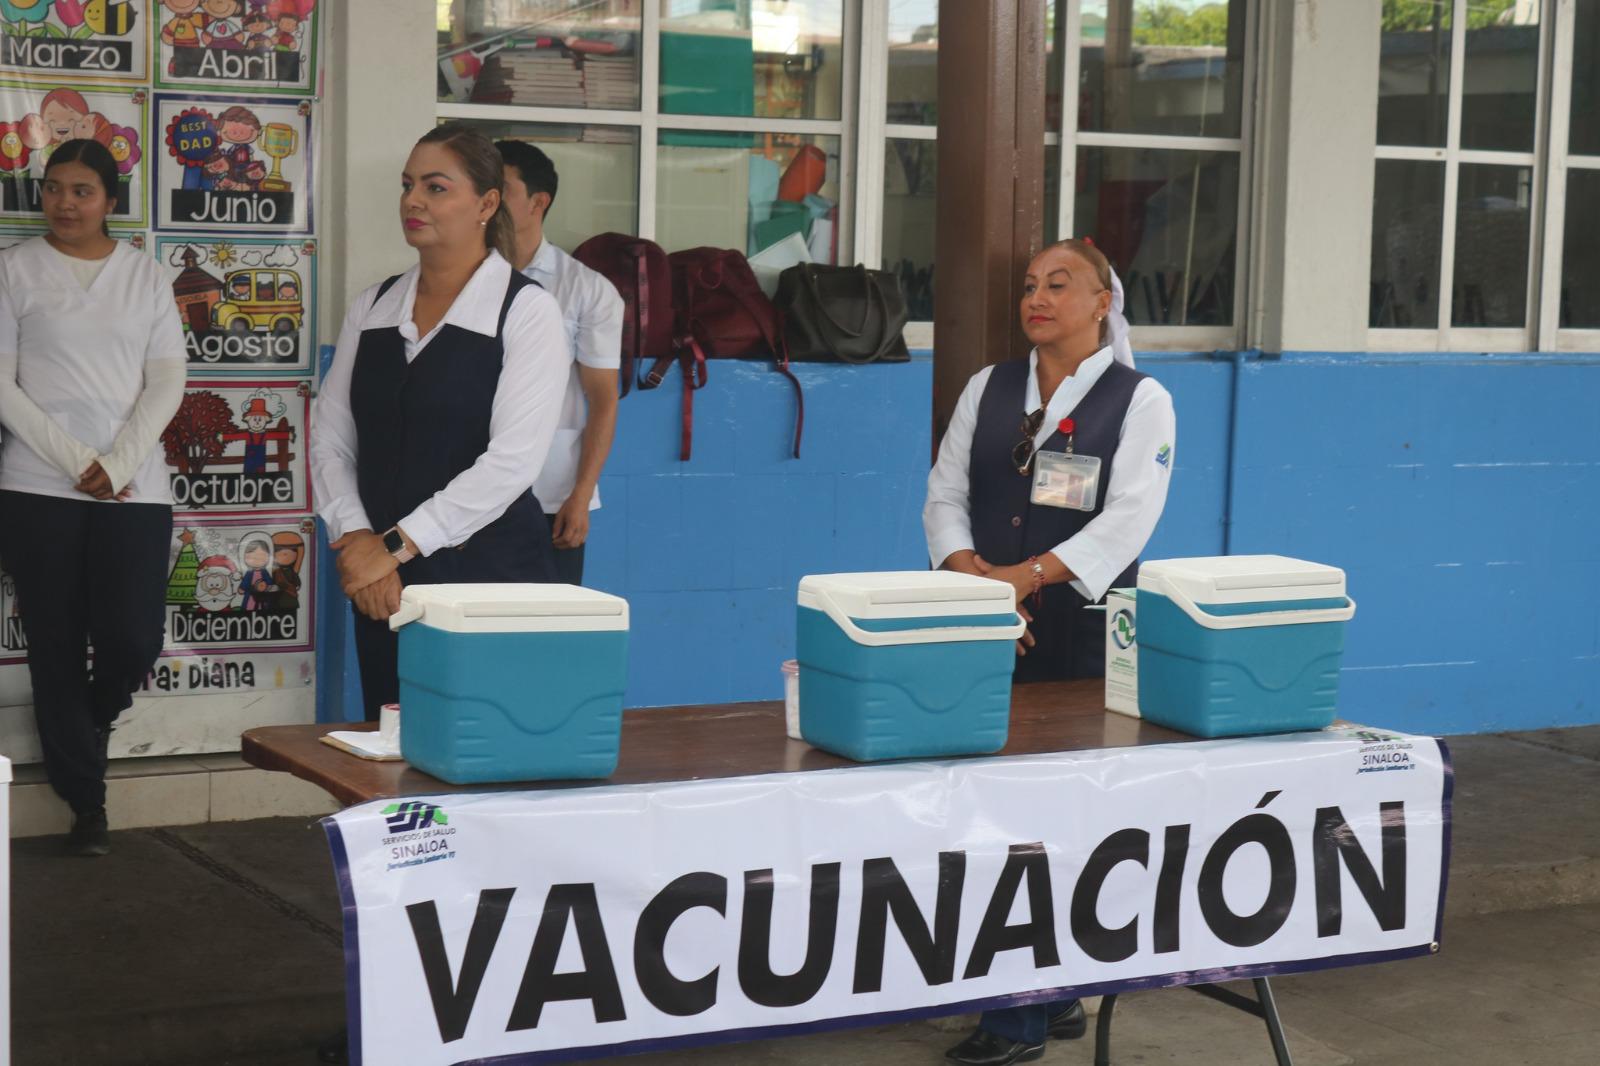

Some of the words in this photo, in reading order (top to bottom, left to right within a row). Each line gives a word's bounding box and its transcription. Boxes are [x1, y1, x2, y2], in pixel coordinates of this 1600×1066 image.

[9, 38, 121, 70] Marzo
[198, 50, 277, 79] Abril
[181, 121, 207, 132] BEST
[180, 137, 212, 151] DAD
[190, 192, 276, 223] Junio
[186, 331, 295, 362] Agosto
[171, 474, 292, 504] Octubre
[172, 611, 296, 641] Diciembre
[1362, 752, 1410, 766] SINALOA
[391, 838, 449, 860] SINALOA
[405, 790, 1406, 1044] VACUNACIÓN
